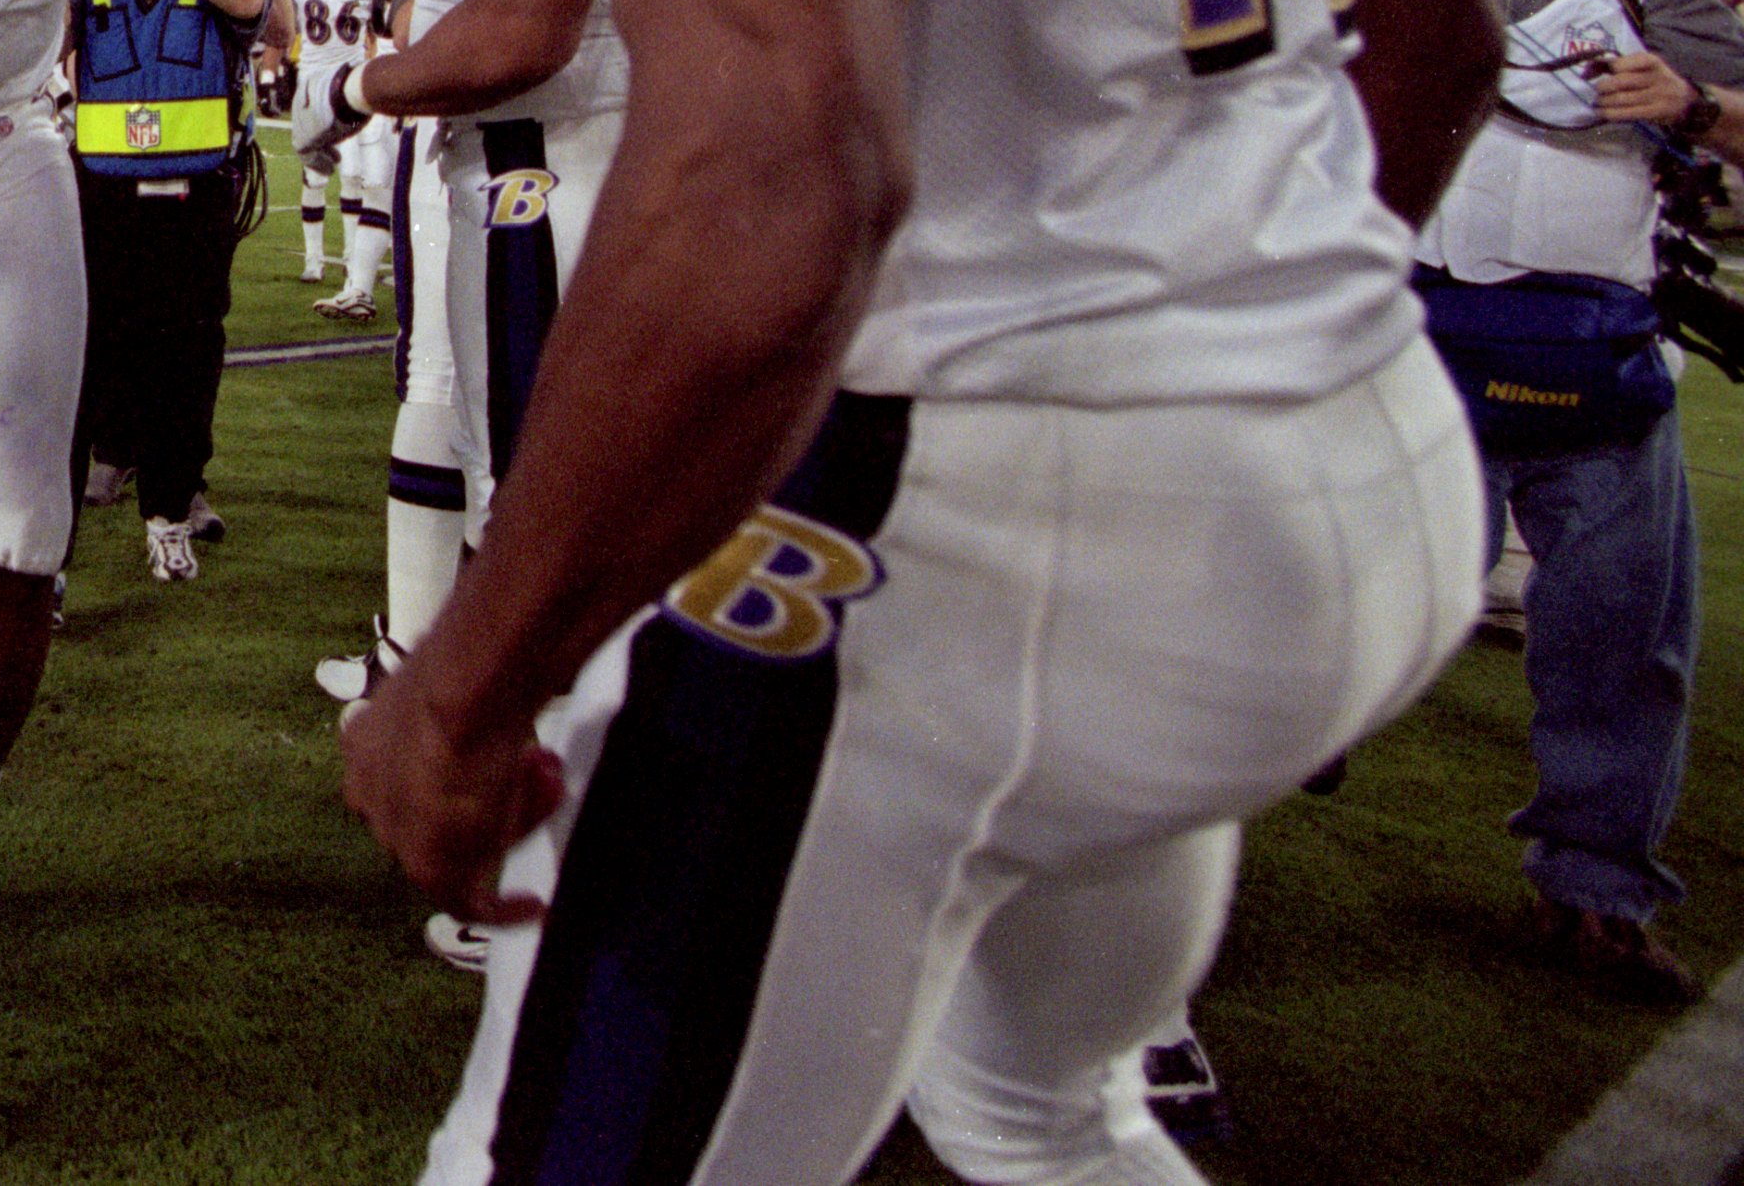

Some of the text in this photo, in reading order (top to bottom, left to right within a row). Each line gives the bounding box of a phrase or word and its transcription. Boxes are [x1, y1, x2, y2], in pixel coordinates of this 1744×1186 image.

[128, 125, 159, 146] NFL
[477, 168, 560, 228] B
[1485, 380, 1581, 408] Nikon
[659, 502, 888, 662] B
